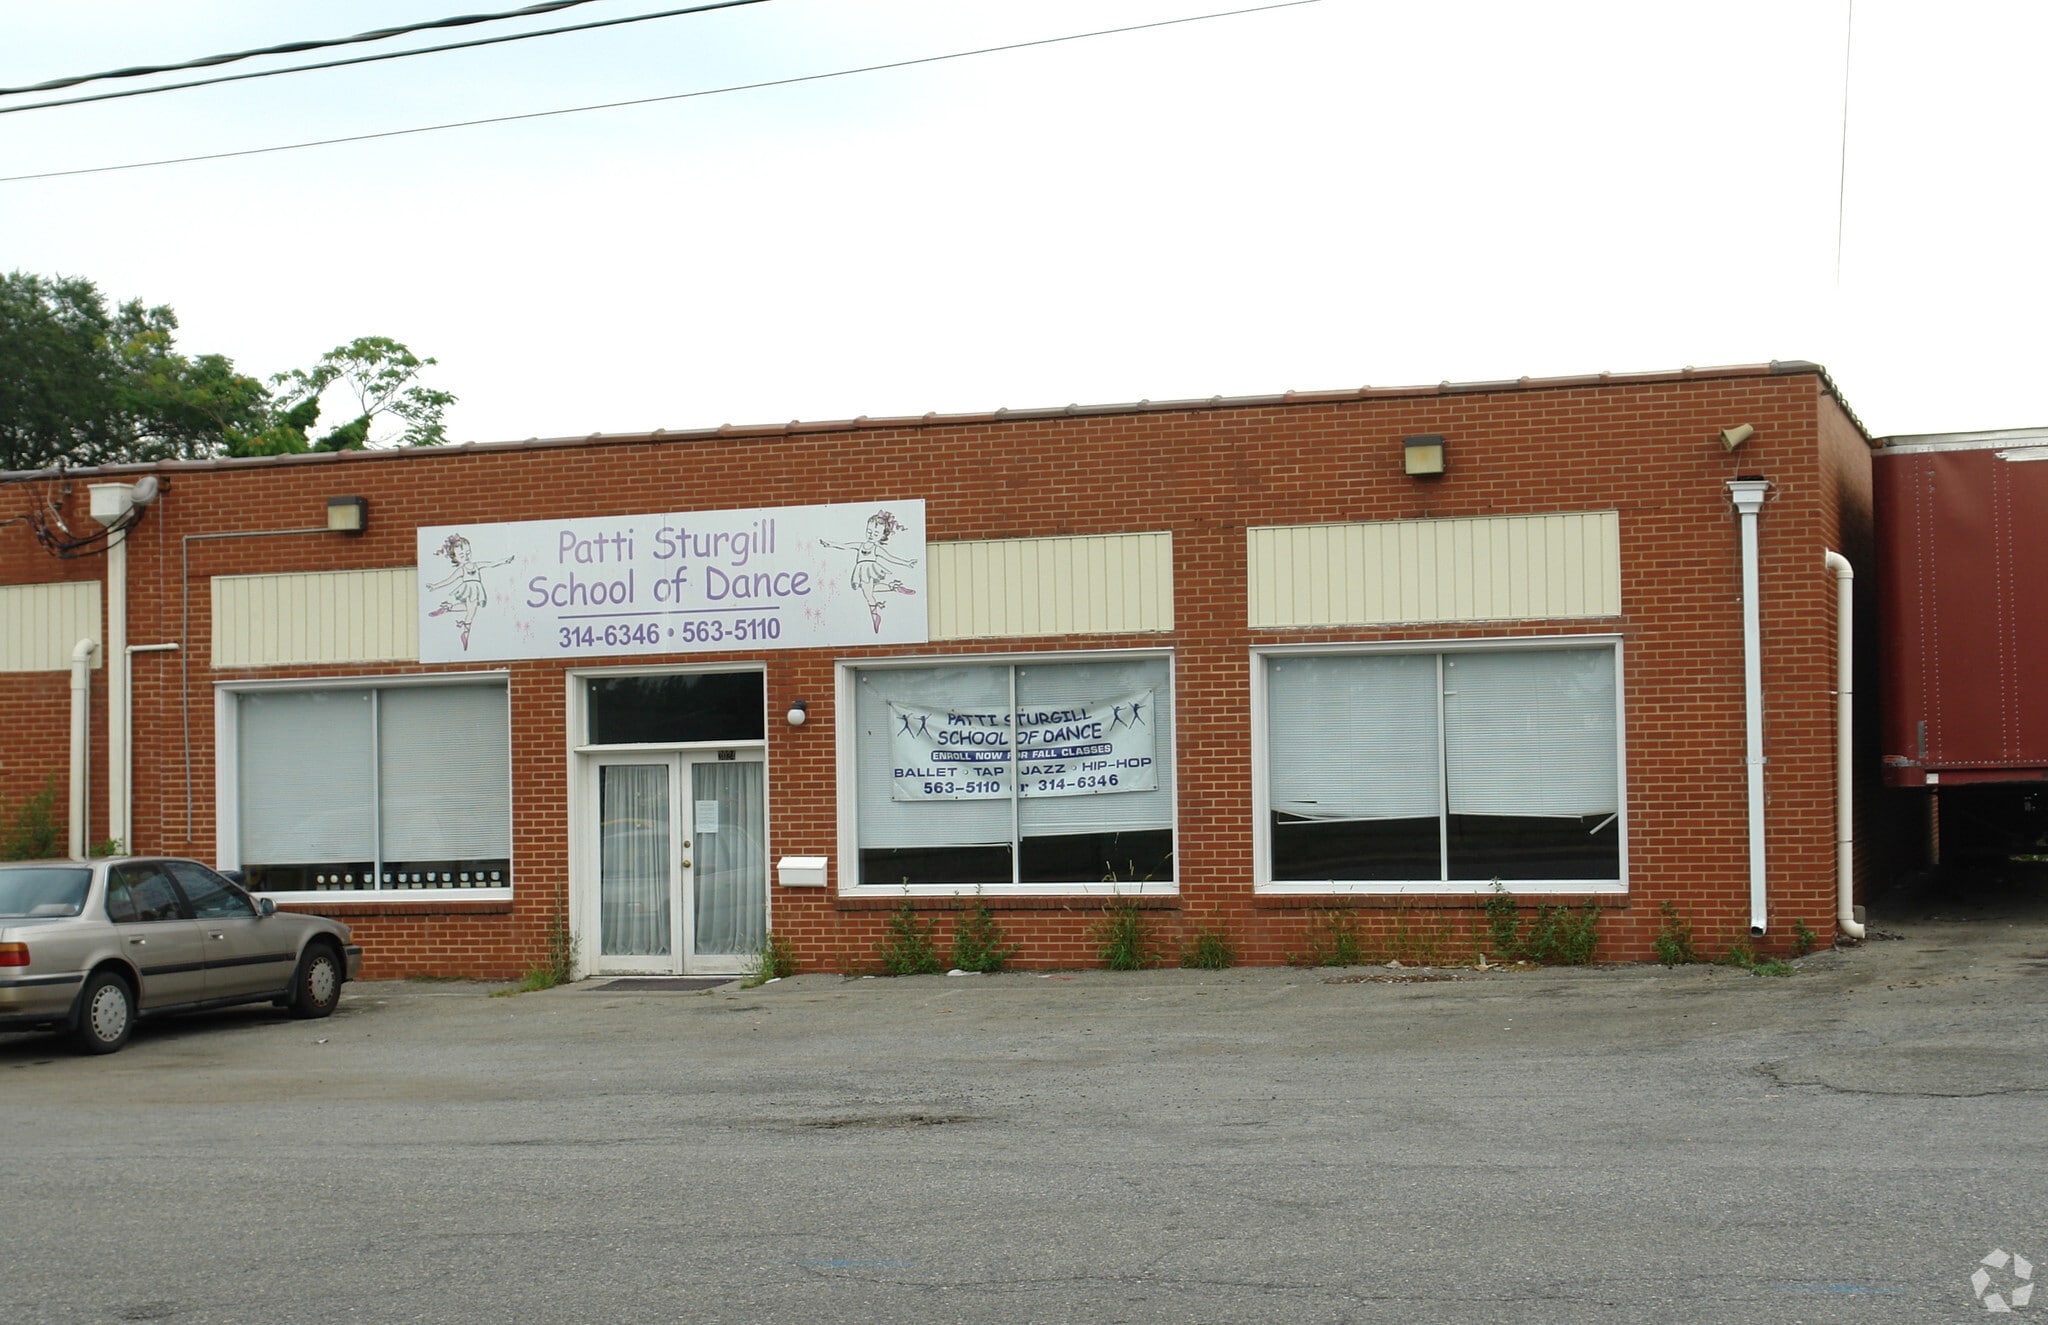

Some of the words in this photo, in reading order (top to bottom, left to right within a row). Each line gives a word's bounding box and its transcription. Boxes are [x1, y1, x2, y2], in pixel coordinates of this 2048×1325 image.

[559, 529, 634, 564] Patti
[653, 519, 775, 567] Sturgill
[527, 569, 635, 608] School
[654, 567, 687, 602] of
[706, 567, 811, 599] Dance
[559, 623, 660, 648] 314-6346
[682, 618, 781, 642] 563-5110
[948, 712, 997, 726] PATTI
[937, 731, 1008, 745] SCHOOL
[1043, 723, 1102, 742] DANCE
[932, 752, 971, 761] ENROLL
[975, 752, 1003, 760] NOW
[1007, 752, 1028, 760] FR
[1032, 749, 1057, 758] FALL
[1061, 745, 1111, 756] CLASSES
[894, 768, 957, 778] BALLET
[973, 768, 1004, 777] TAP
[1021, 764, 1066, 775] JAZZ
[1082, 758, 1152, 772] HIP-HOP
[924, 782, 1000, 794] 563-5110
[1038, 774, 1119, 790] 314-6346
